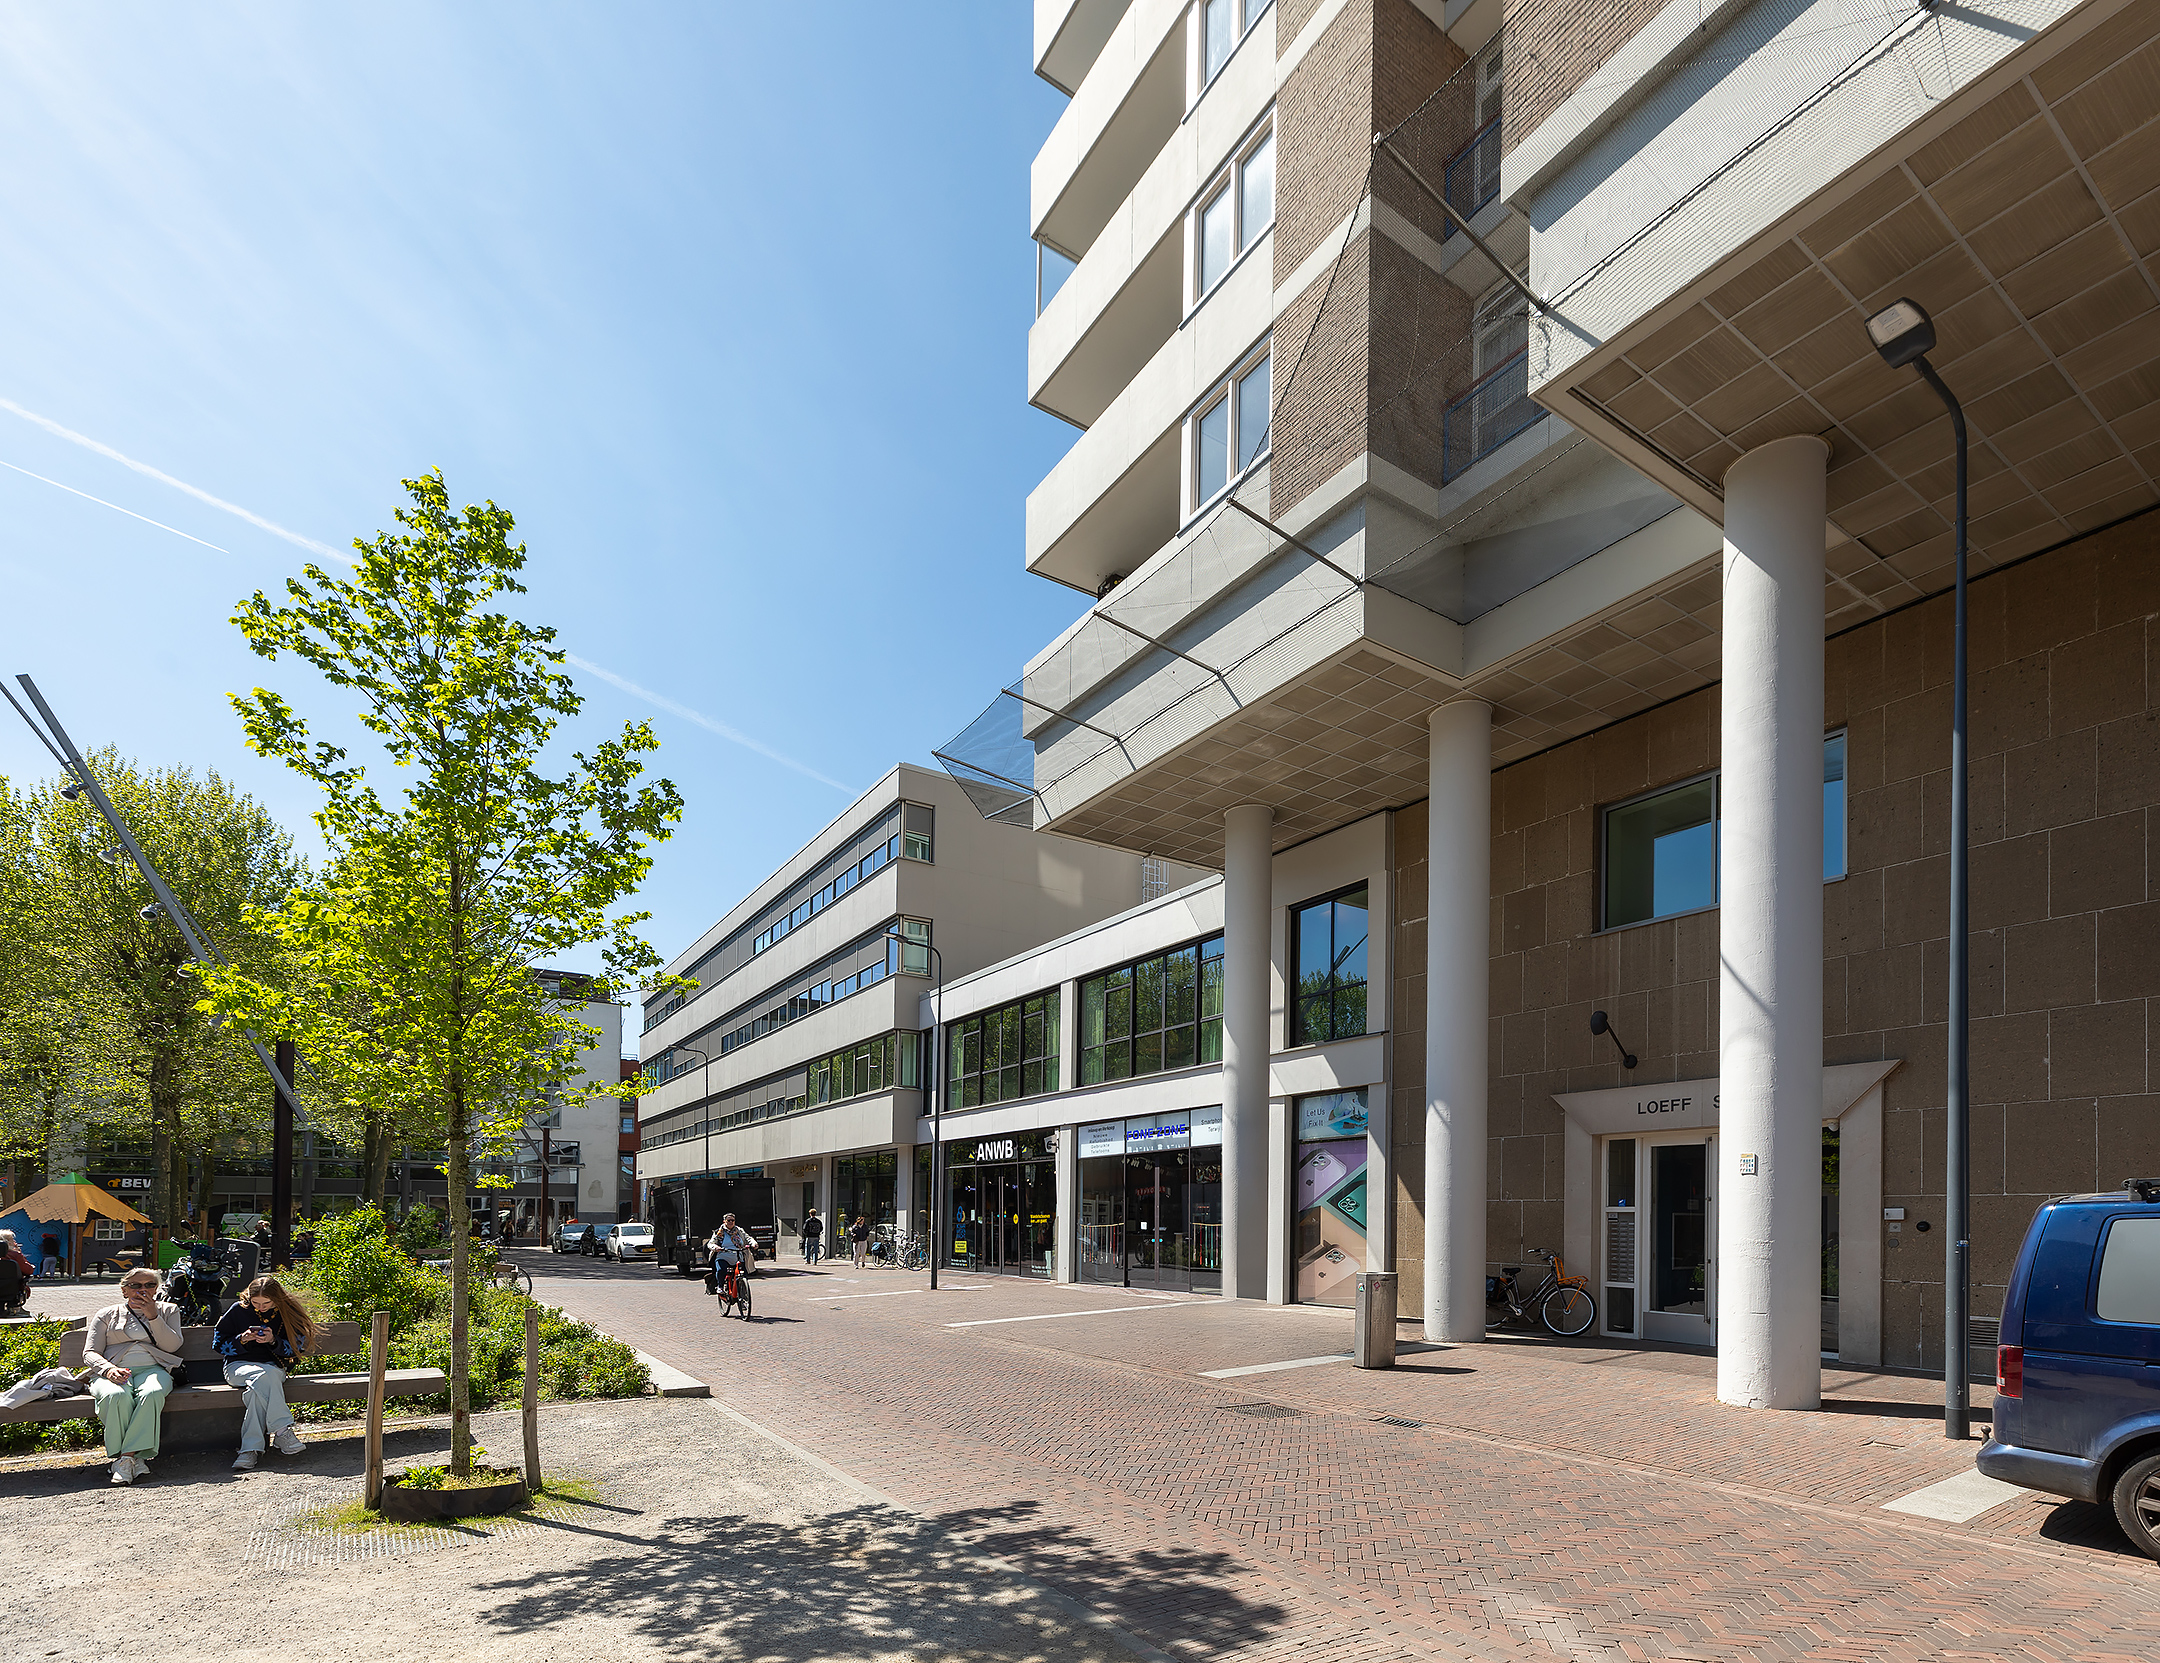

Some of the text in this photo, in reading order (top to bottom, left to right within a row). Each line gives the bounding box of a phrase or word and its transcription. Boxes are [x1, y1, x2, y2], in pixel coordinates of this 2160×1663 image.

[1317, 1108, 1326, 1116] Us
[1637, 1097, 1692, 1114] LOEFF
[1126, 1123, 1186, 1141] FONE ZONE
[977, 1139, 1014, 1161] ANWB
